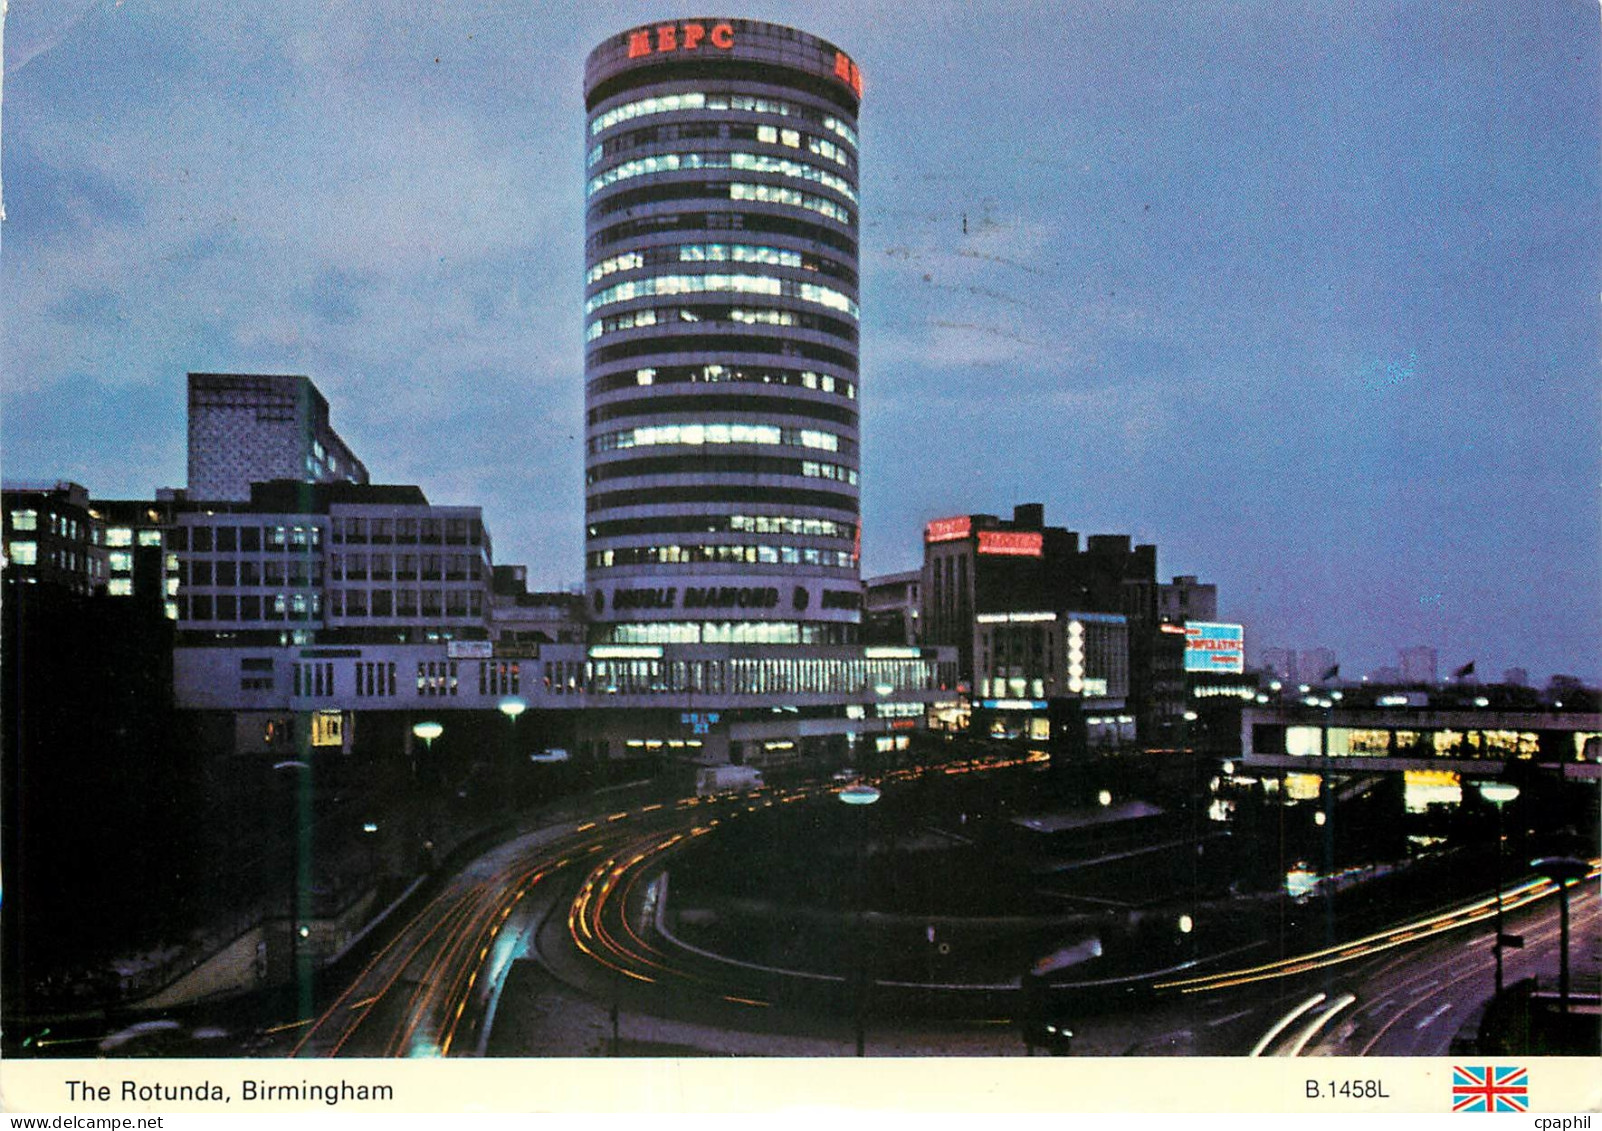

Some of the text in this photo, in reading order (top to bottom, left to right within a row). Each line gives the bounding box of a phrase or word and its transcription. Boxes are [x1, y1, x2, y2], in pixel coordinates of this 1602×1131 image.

[628, 24, 734, 58] MEPC
[66, 1080, 392, 1105] The Rotunda, Birmingham
[1306, 1080, 1389, 1098] B.1458L
